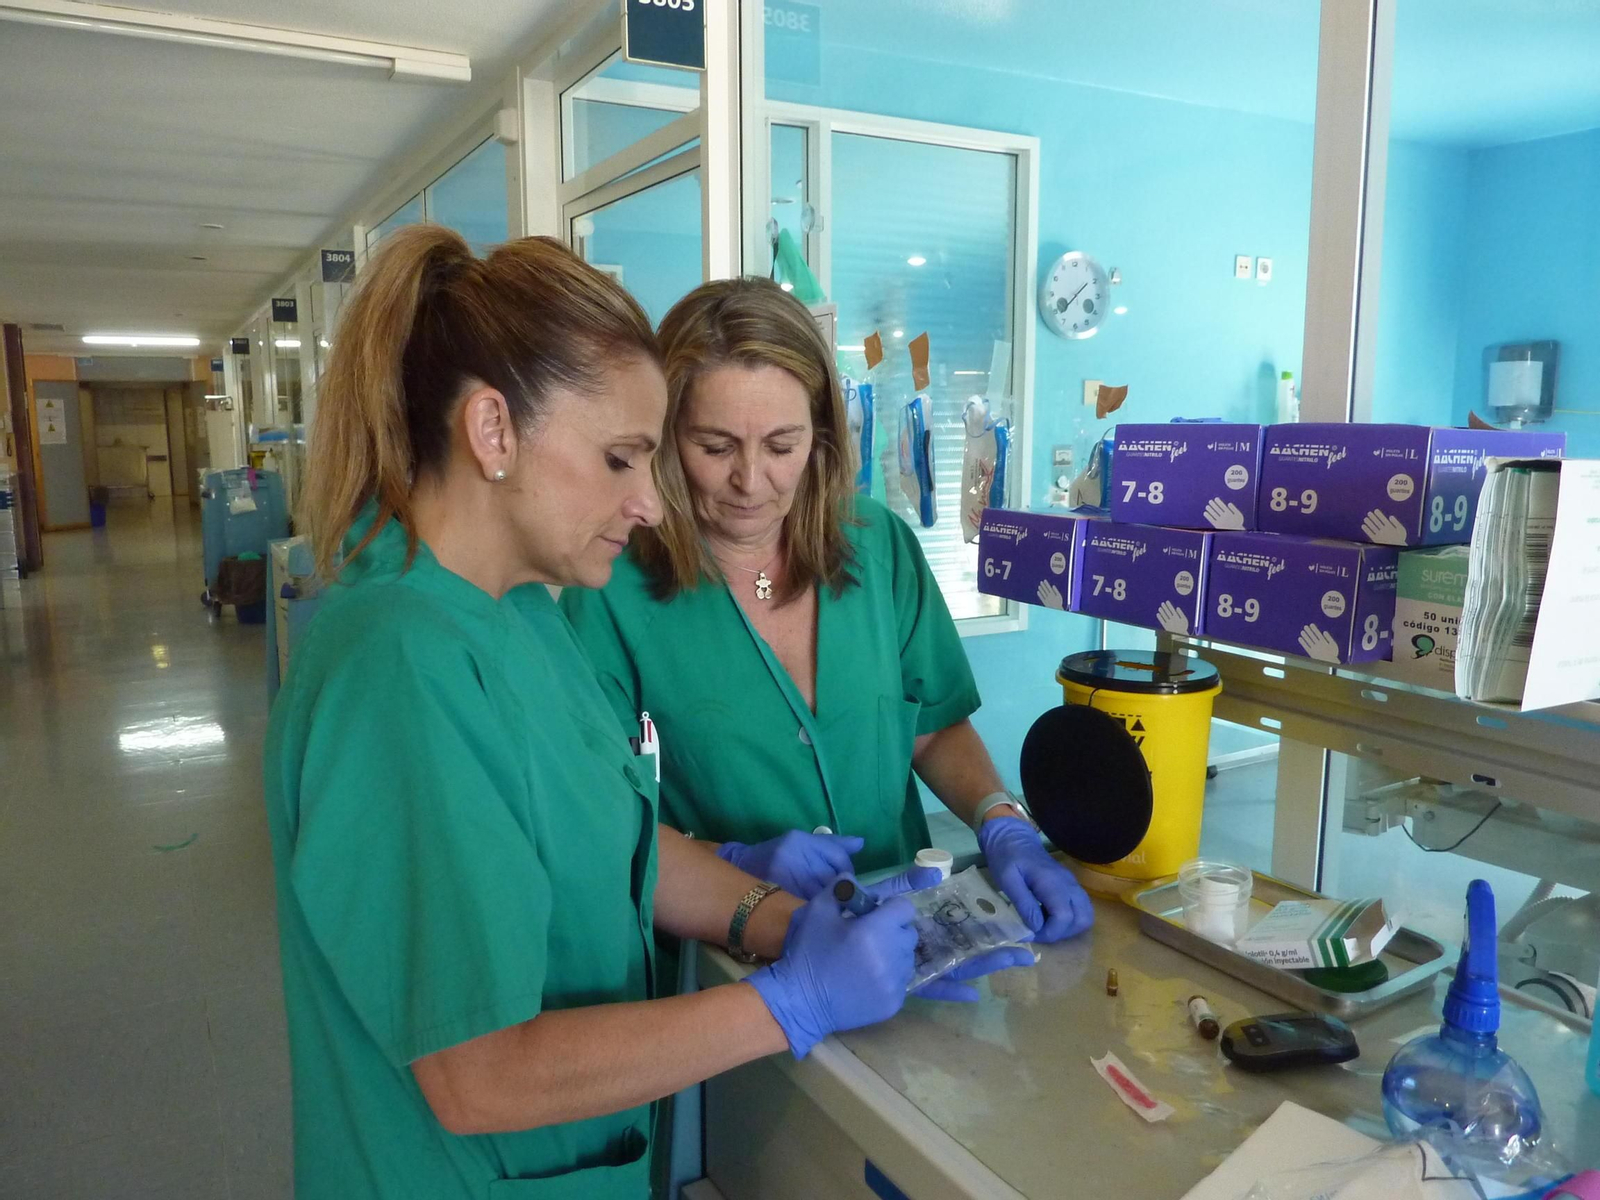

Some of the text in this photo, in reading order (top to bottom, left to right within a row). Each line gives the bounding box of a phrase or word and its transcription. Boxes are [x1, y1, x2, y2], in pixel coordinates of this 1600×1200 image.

[326, 252, 351, 263] 3804
[275, 300, 294, 308] 3803
[1118, 440, 1172, 452] AACHEN
[1240, 442, 1250, 452] M
[1270, 443, 1347, 469] AACHEN feel
[1410, 449, 1419, 460] L
[1433, 449, 1475, 465] AACHEN
[1121, 480, 1164, 505] 7-8
[1269, 487, 1318, 514] 8-9
[1429, 495, 1468, 533] 8-9
[983, 522, 1019, 536] AACHEN
[1064, 532, 1070, 542] S
[1091, 536, 1135, 551] AACHEN
[1188, 549, 1198, 560] M
[984, 557, 1012, 580] 6-7
[1217, 551, 1286, 581] AACHEN feel
[1341, 567, 1349, 578] L
[1092, 574, 1127, 601] 7-8
[1328, 595, 1340, 603] 200
[1217, 593, 1260, 623] 8-9
[1424, 612, 1437, 621] 50
[1362, 614, 1397, 651] 8-
[1403, 620, 1440, 633] código
